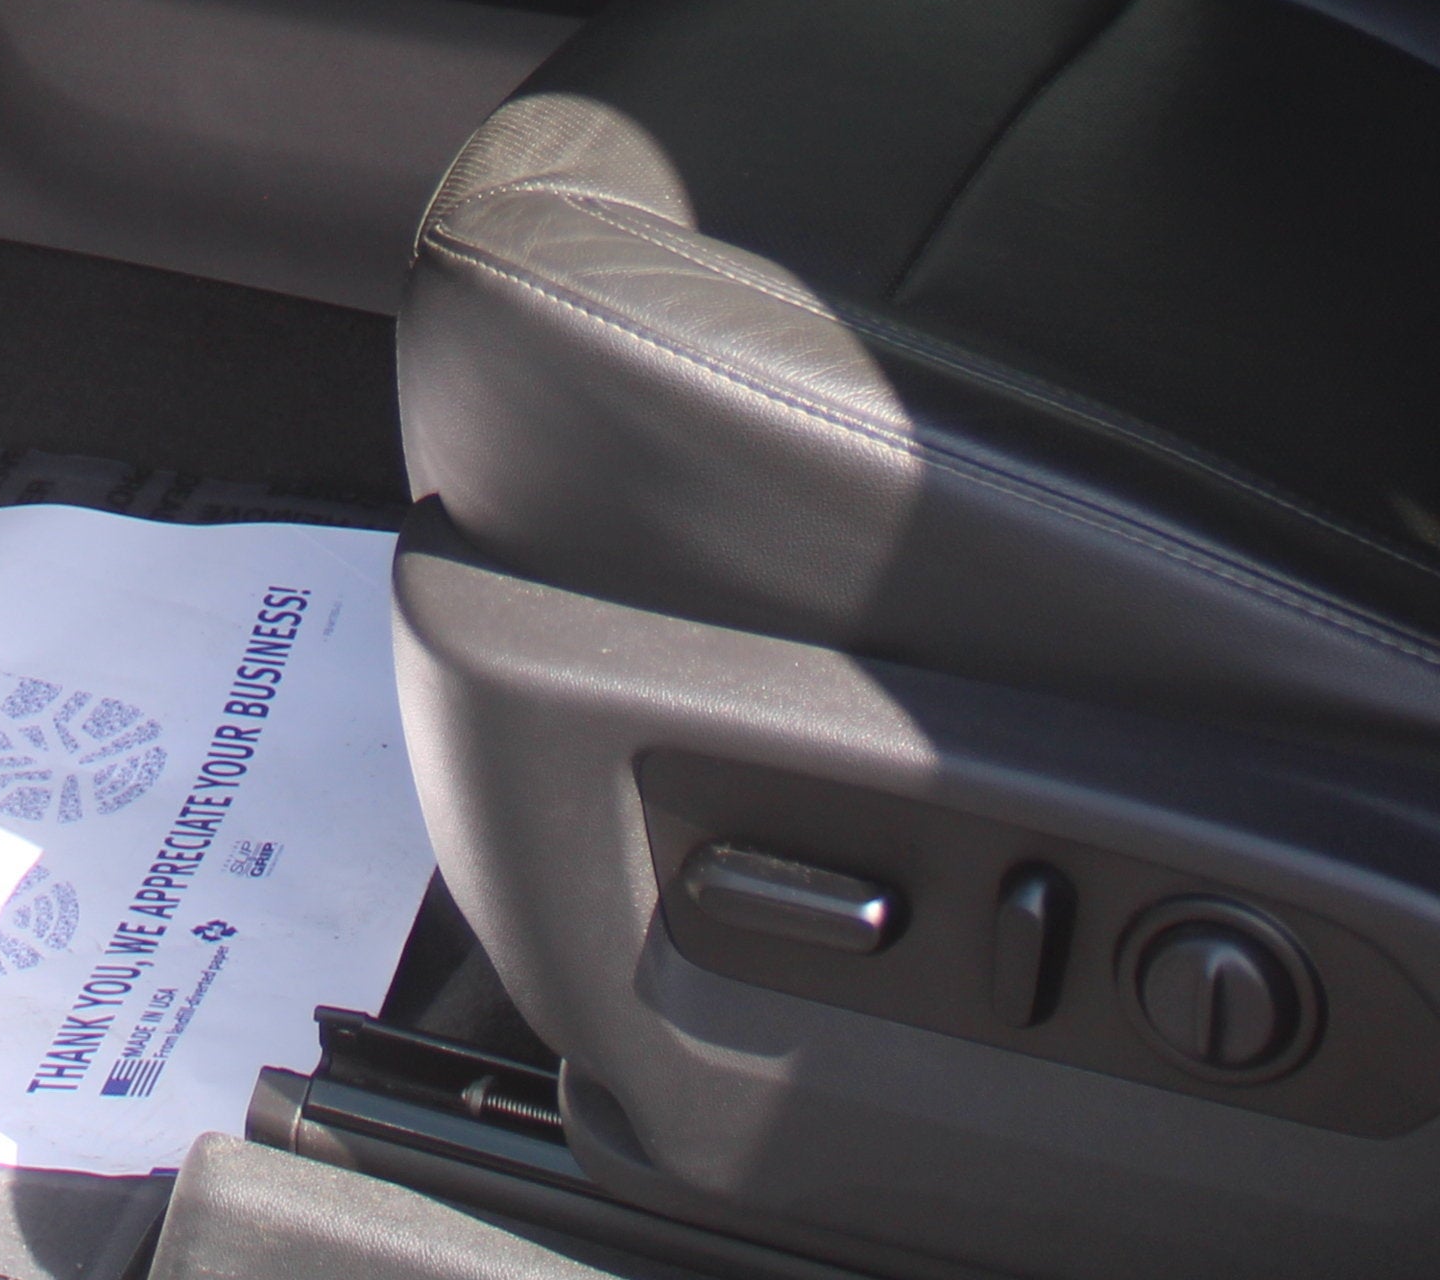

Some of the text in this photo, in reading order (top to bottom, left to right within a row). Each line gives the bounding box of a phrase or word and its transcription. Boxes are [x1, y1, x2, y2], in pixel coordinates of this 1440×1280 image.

[224, 585, 312, 720] BUSINESS!
[192, 723, 264, 808] YOUR
[128, 793, 234, 921] APPRECIATE
[230, 840, 251, 873] SLIP
[250, 842, 274, 877] GRIP
[105, 920, 166, 962] WE
[73, 959, 156, 1032] YOU,
[121, 988, 178, 1058] MADE IN USA
[26, 1014, 115, 1095] THANK
